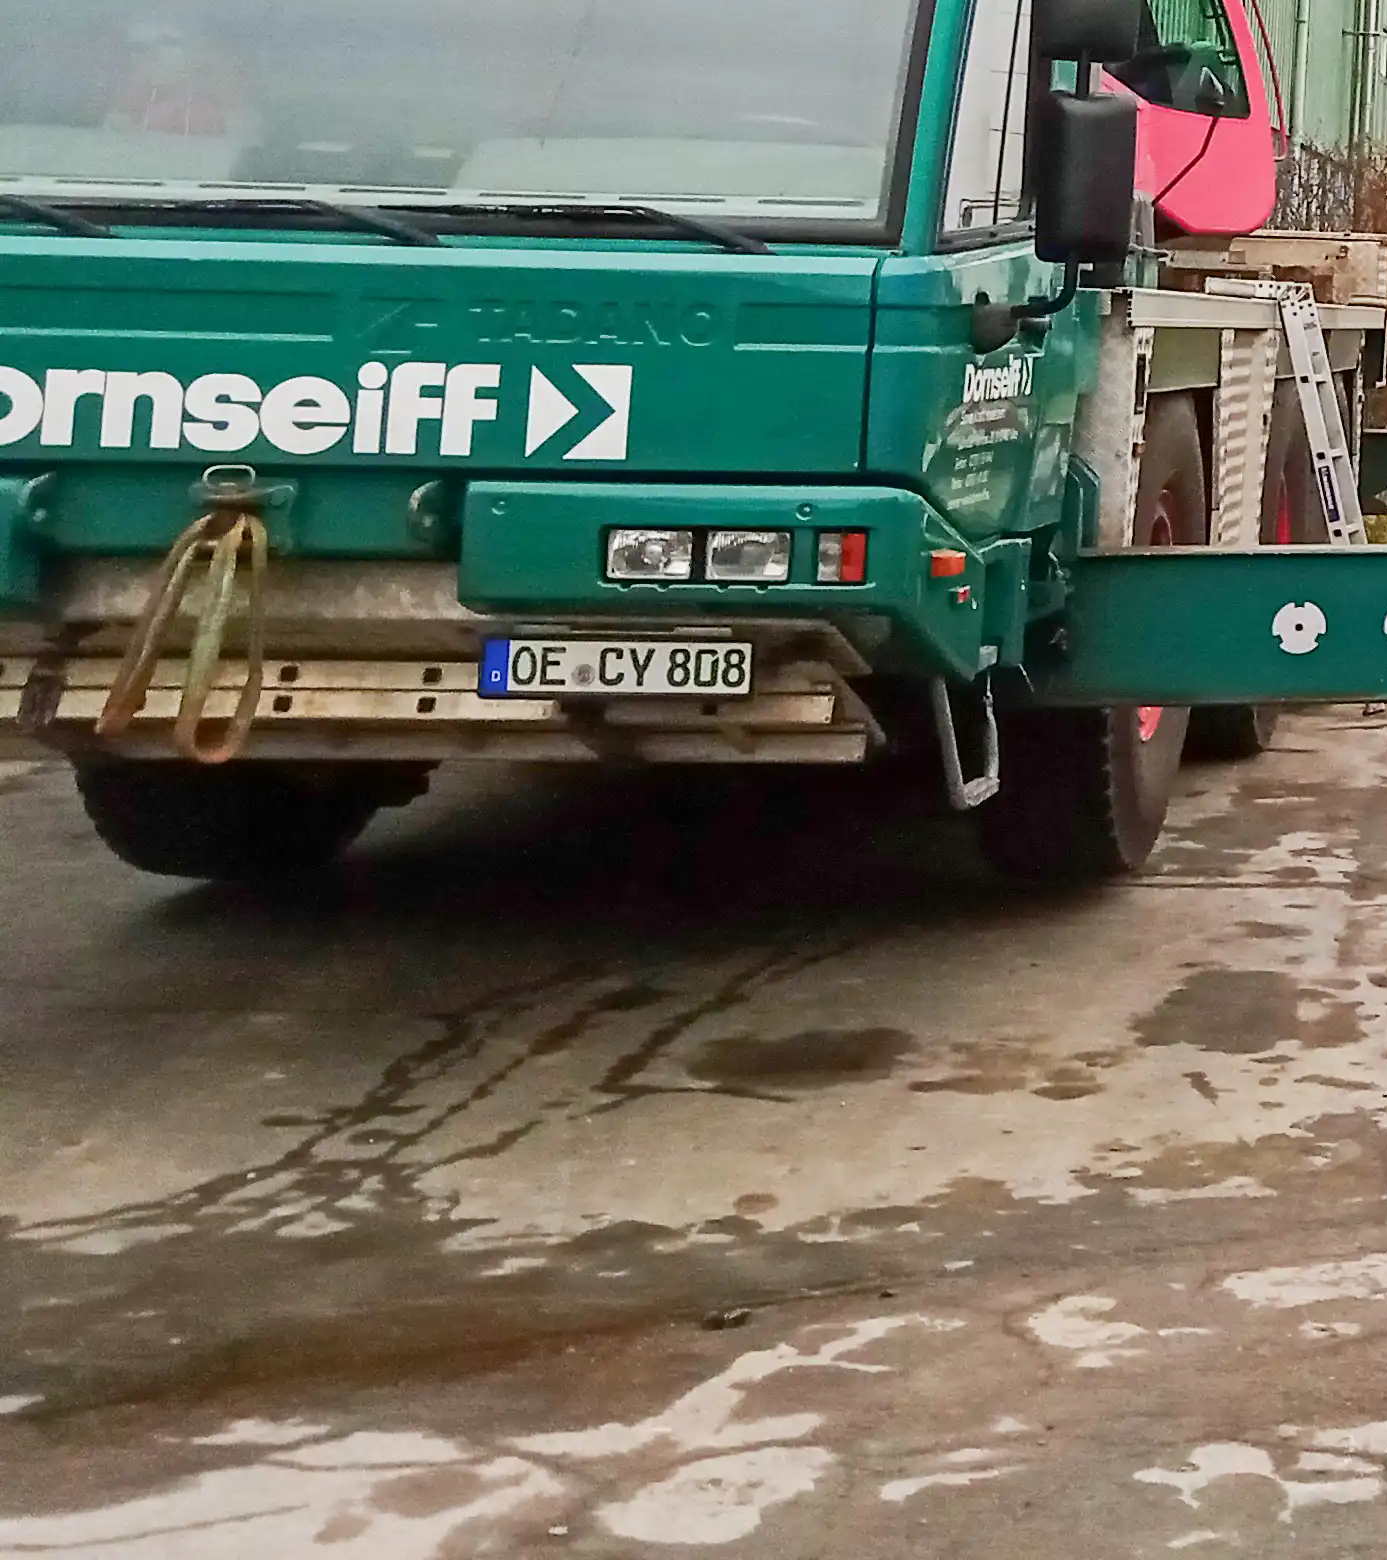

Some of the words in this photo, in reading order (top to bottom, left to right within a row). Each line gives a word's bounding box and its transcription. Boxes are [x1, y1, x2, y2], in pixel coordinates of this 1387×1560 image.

[511, 645, 568, 688] OE
[599, 646, 656, 687] CY
[666, 647, 746, 688] 808
